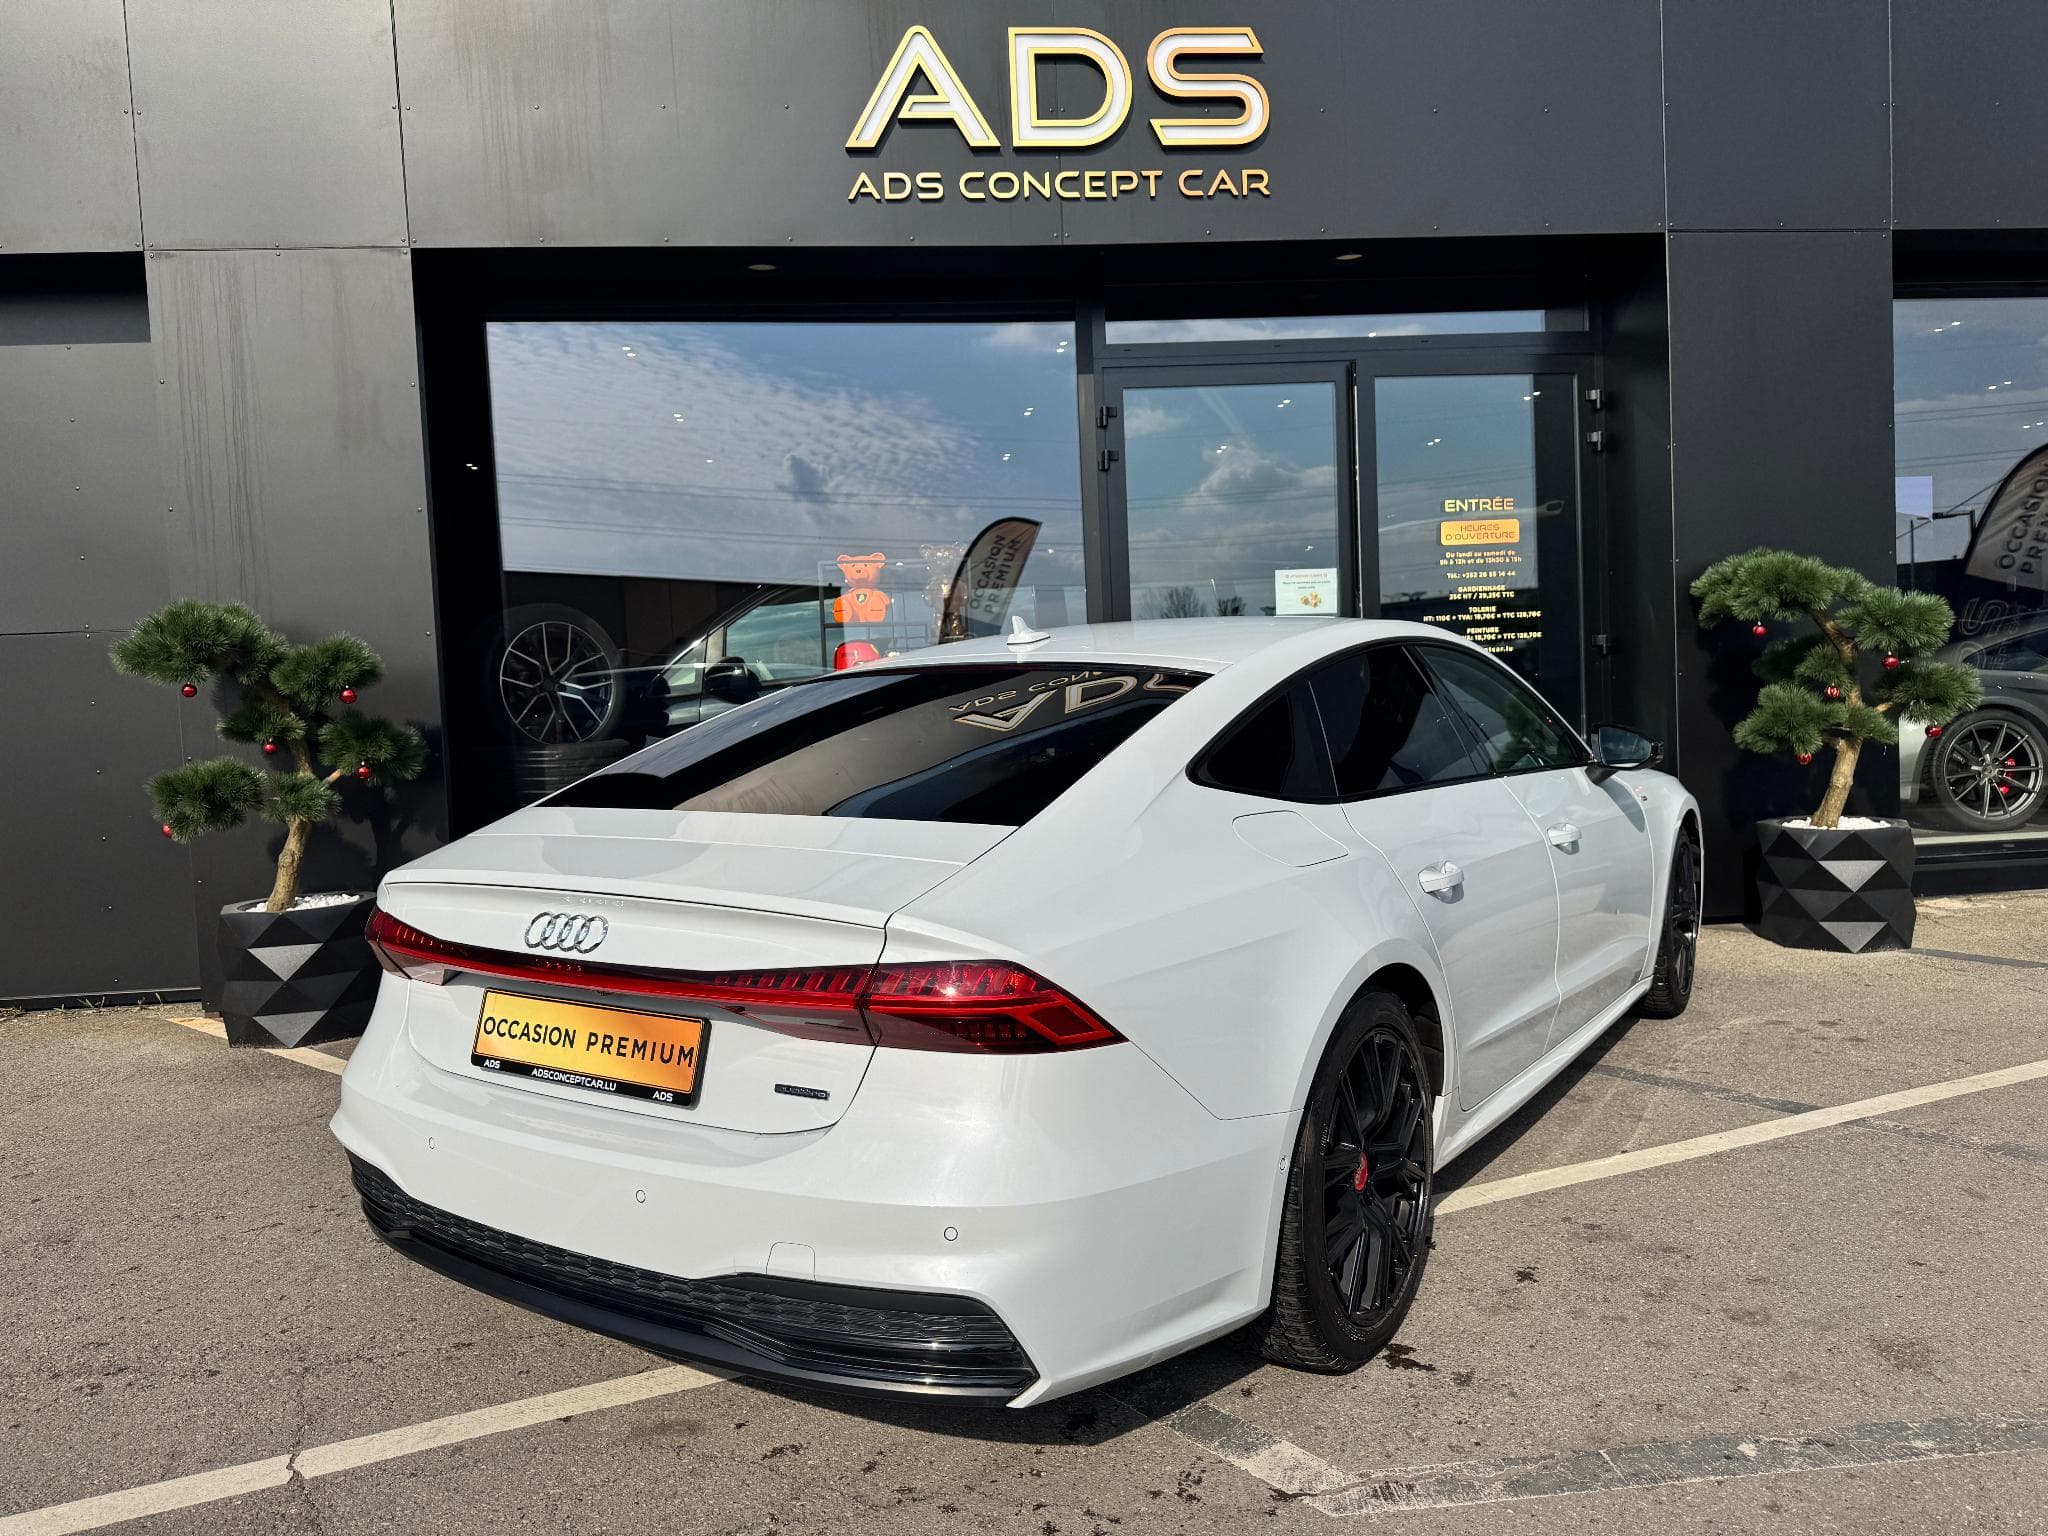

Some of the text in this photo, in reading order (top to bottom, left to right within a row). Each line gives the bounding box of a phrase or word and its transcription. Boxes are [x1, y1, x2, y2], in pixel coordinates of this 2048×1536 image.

[845, 24, 1270, 150] ADS
[847, 168, 1270, 200] ADS CONCEPT CAR
[1444, 496, 1514, 512] ENTRÉE
[1460, 524, 1500, 532] HEURES
[969, 534, 1006, 610] OCCASION
[984, 539, 1020, 614] PREMIUM
[483, 1016, 695, 1067] OCCASION PREMIUM
[483, 1058, 500, 1069] ADS
[531, 1067, 617, 1092] ADSCONCEPTCAR.LU
[652, 1090, 674, 1102] ADS
